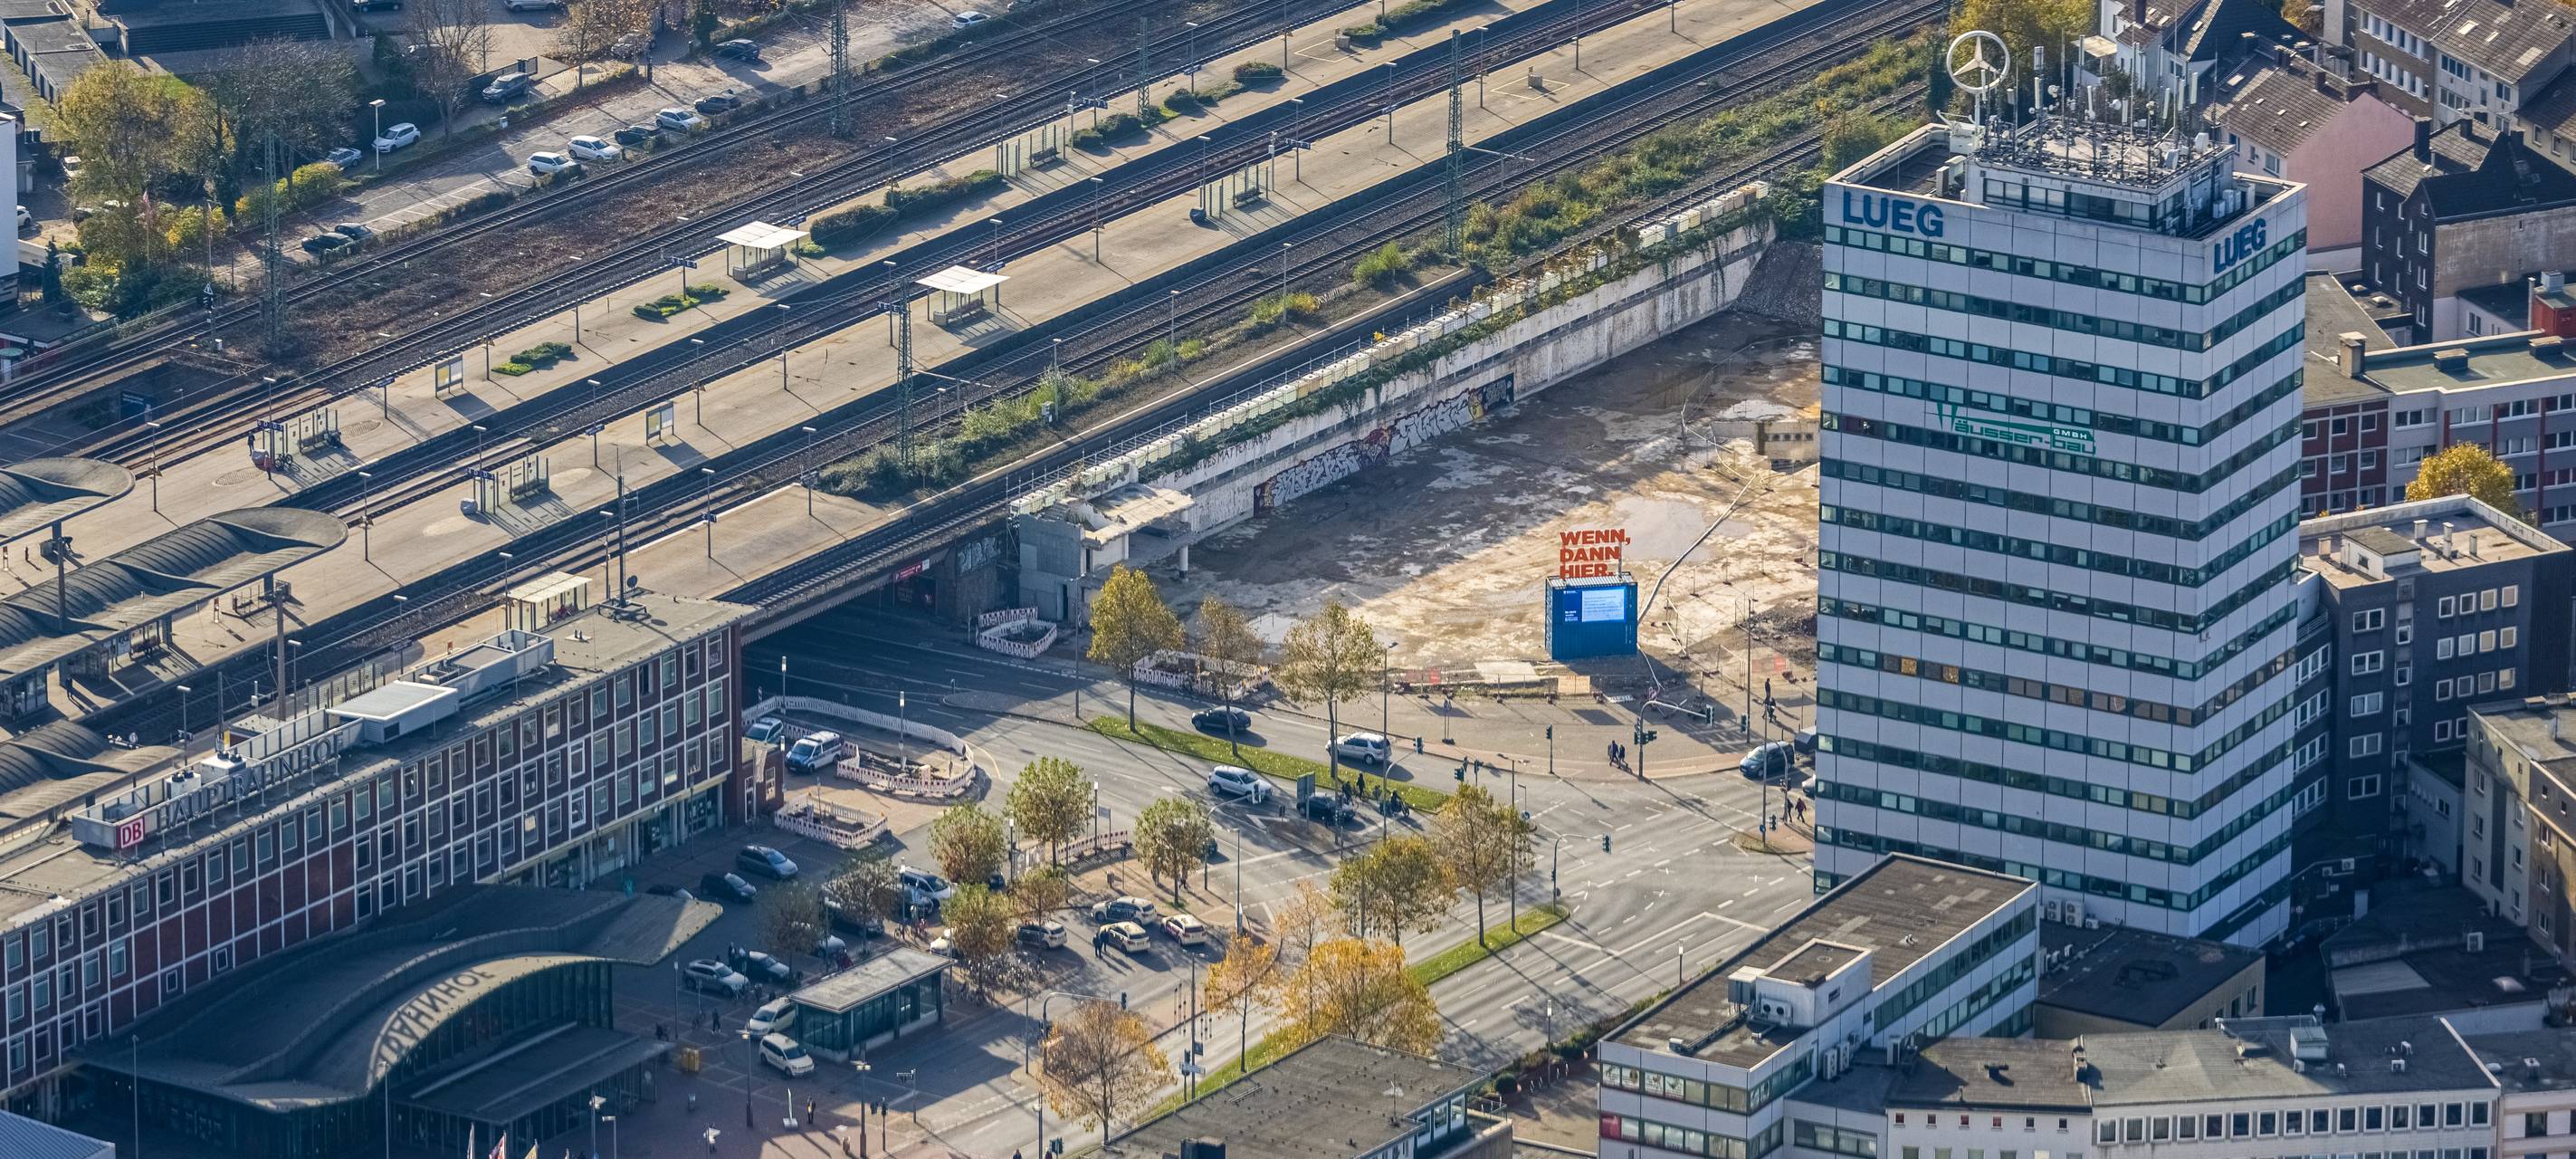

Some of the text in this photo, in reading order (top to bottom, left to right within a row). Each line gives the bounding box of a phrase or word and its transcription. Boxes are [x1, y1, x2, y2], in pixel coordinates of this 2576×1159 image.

[1843, 191, 1943, 237] LUEG
[2214, 217, 2266, 274] LUEG
[2053, 428, 2088, 440] GMBH
[1560, 528, 1631, 545] WENN,
[1560, 546, 1620, 561] DANN
[1560, 563, 1614, 580] HIER.
[157, 732, 343, 830] HAUPTBAHNHOF
[122, 821, 142, 846] DB
